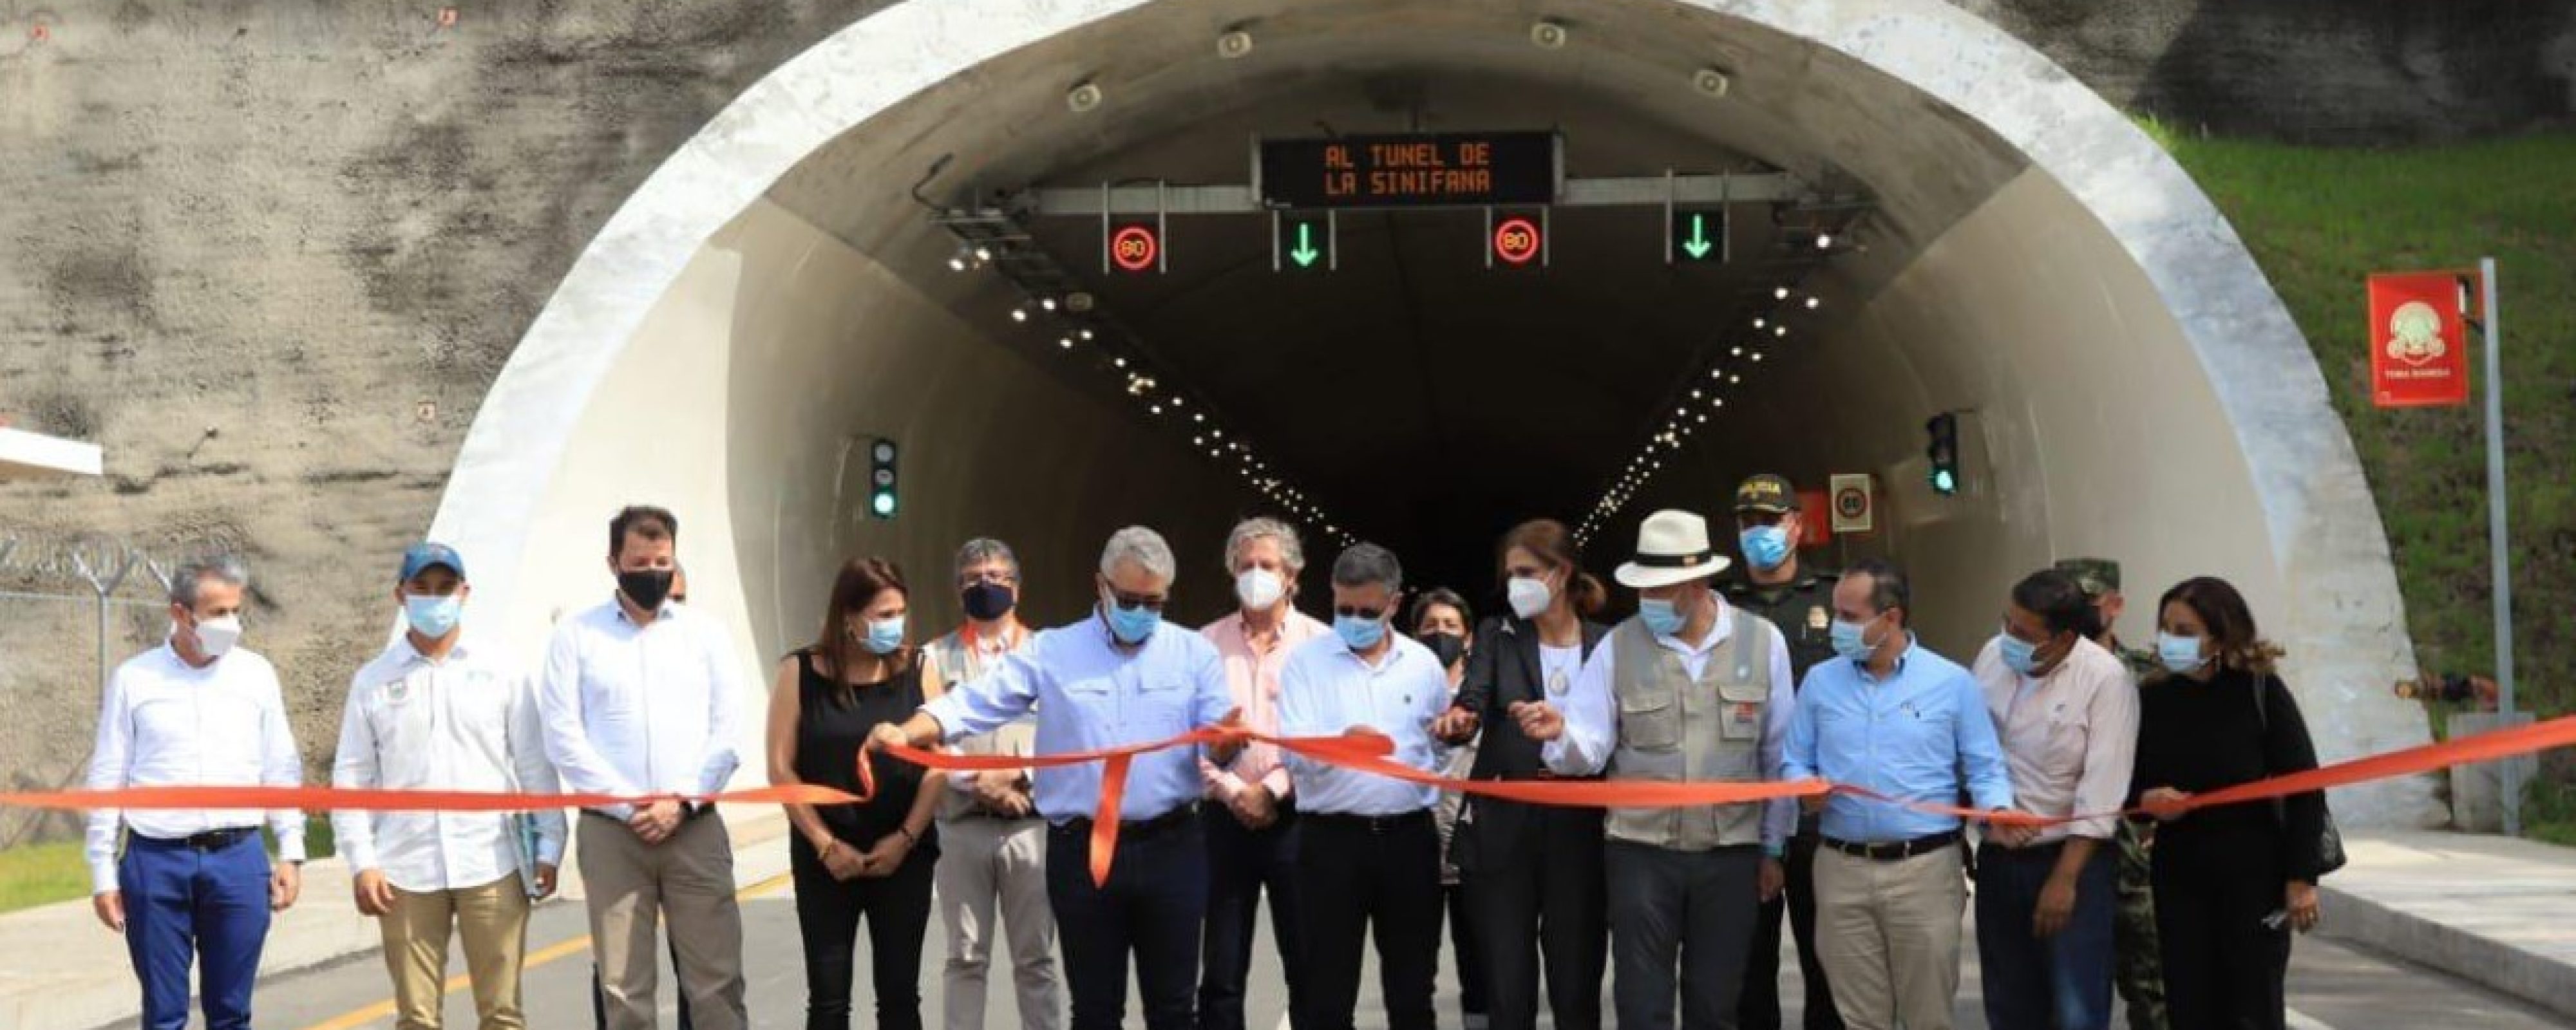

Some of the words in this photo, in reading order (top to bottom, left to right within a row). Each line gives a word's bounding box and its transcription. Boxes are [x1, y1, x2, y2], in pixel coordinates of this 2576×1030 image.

[1325, 145, 1354, 167] AL
[1371, 144, 1443, 165] TUNEL
[1460, 142, 1490, 164] DE
[1326, 173, 1355, 194] LA
[1372, 170, 1490, 194] SINIFANA
[1122, 241, 1145, 256] 80
[1504, 232, 1528, 249] 80
